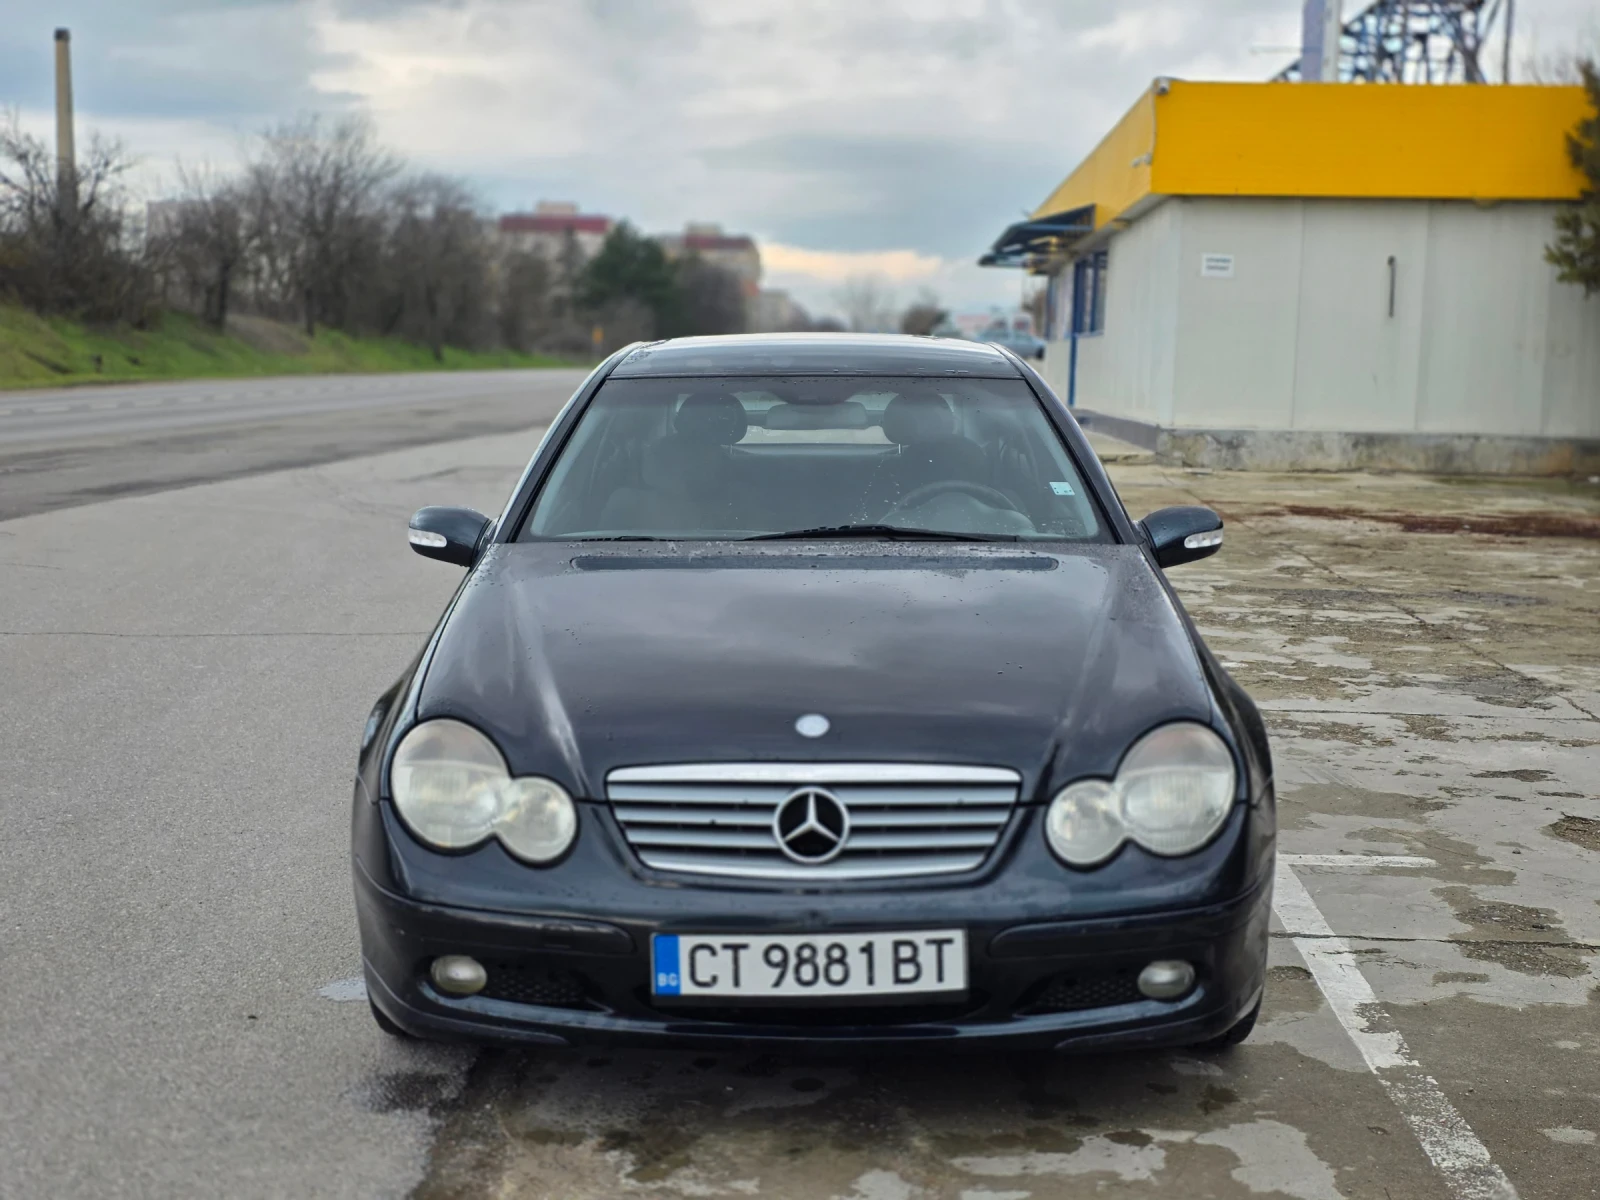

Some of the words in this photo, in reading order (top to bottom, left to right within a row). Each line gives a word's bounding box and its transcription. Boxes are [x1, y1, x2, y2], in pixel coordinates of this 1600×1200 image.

[688, 943, 750, 988] CT
[762, 941, 876, 988] 9881
[892, 938, 955, 986] BT
[658, 973, 679, 987] BG
